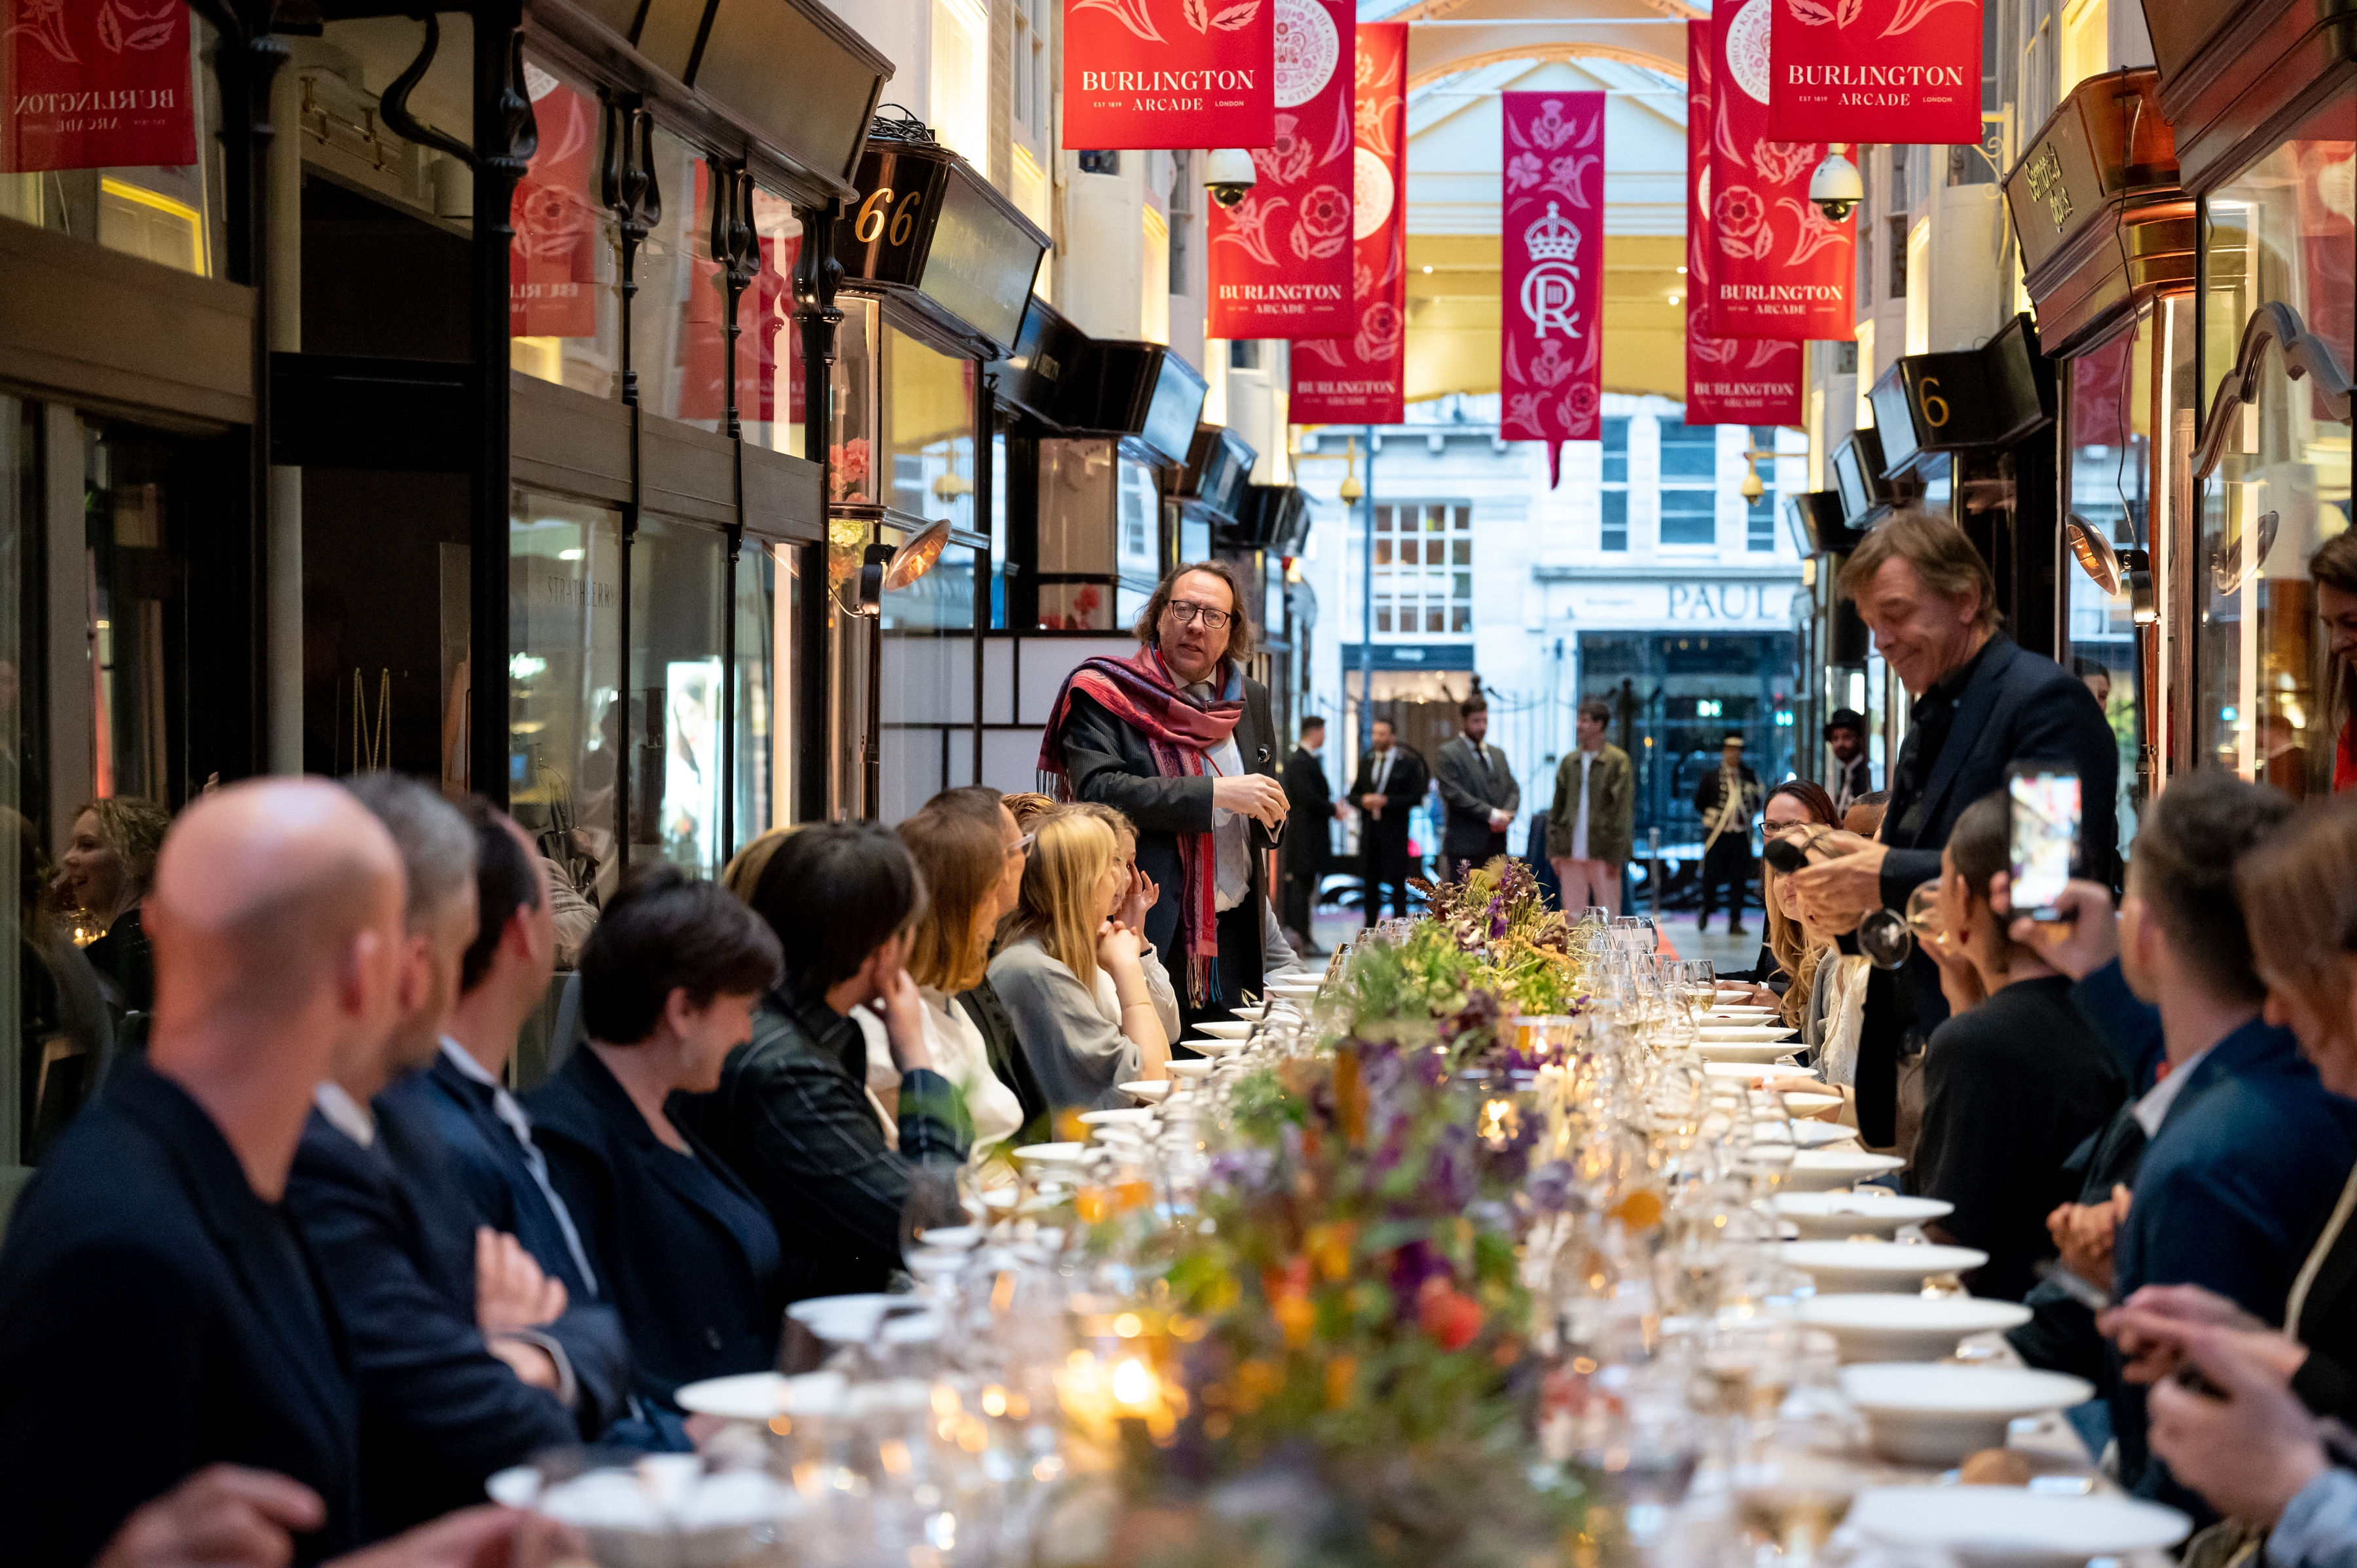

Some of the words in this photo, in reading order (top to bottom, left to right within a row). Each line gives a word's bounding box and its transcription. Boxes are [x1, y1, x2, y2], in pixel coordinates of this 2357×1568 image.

[1732, 37, 1769, 98] CORONATIO
[1789, 65, 1963, 86] BURLINGTON
[1082, 70, 1254, 90] BURLINGTON
[1132, 98, 1203, 111] ARCADE
[1838, 92, 1910, 106] ARCADE
[855, 187, 921, 246] 66
[1219, 284, 1342, 300] BURLINGTON
[1720, 284, 1843, 301] BURLINGTON
[1755, 304, 1806, 314] ARCADE
[1919, 376, 1949, 427] 6
[1667, 585, 1778, 619] PAUL
